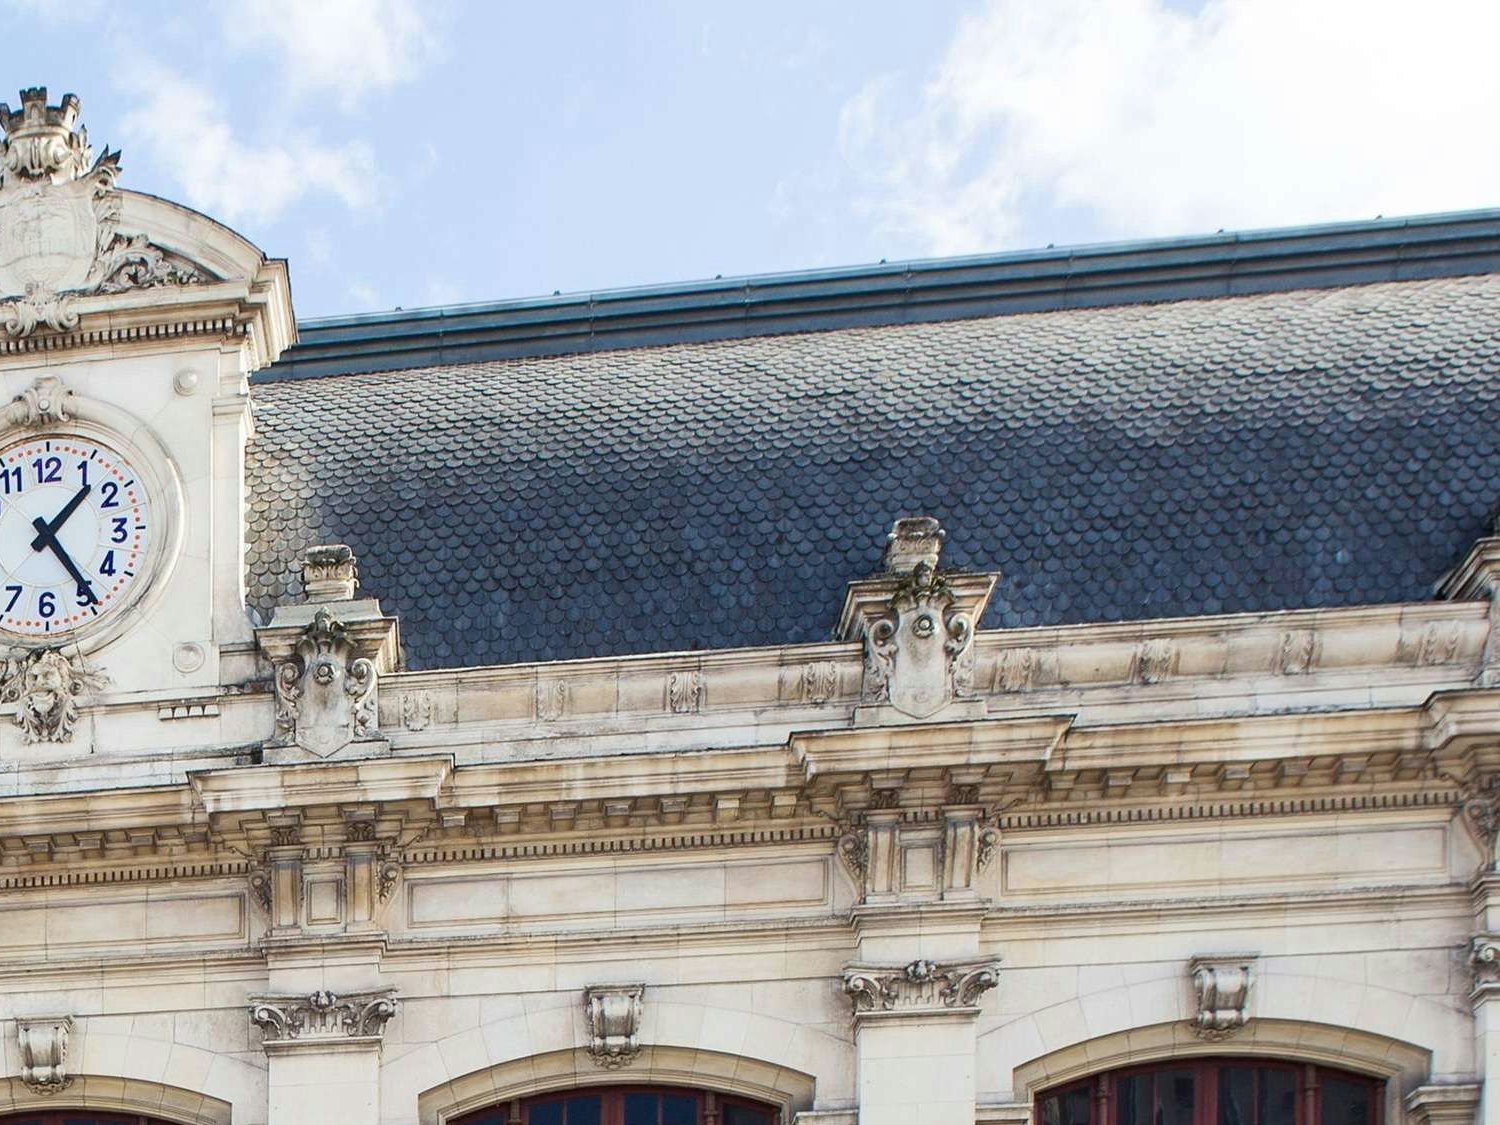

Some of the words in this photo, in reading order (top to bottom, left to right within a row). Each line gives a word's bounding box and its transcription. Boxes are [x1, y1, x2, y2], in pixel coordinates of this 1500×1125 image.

[0, 466, 23, 494] 11
[32, 457, 62, 484] 12
[77, 461, 89, 486] 1
[101, 482, 119, 508] 2
[111, 517, 128, 543] 3
[99, 550, 116, 577] 4
[5, 586, 23, 612] 7
[38, 592, 56, 618] 6
